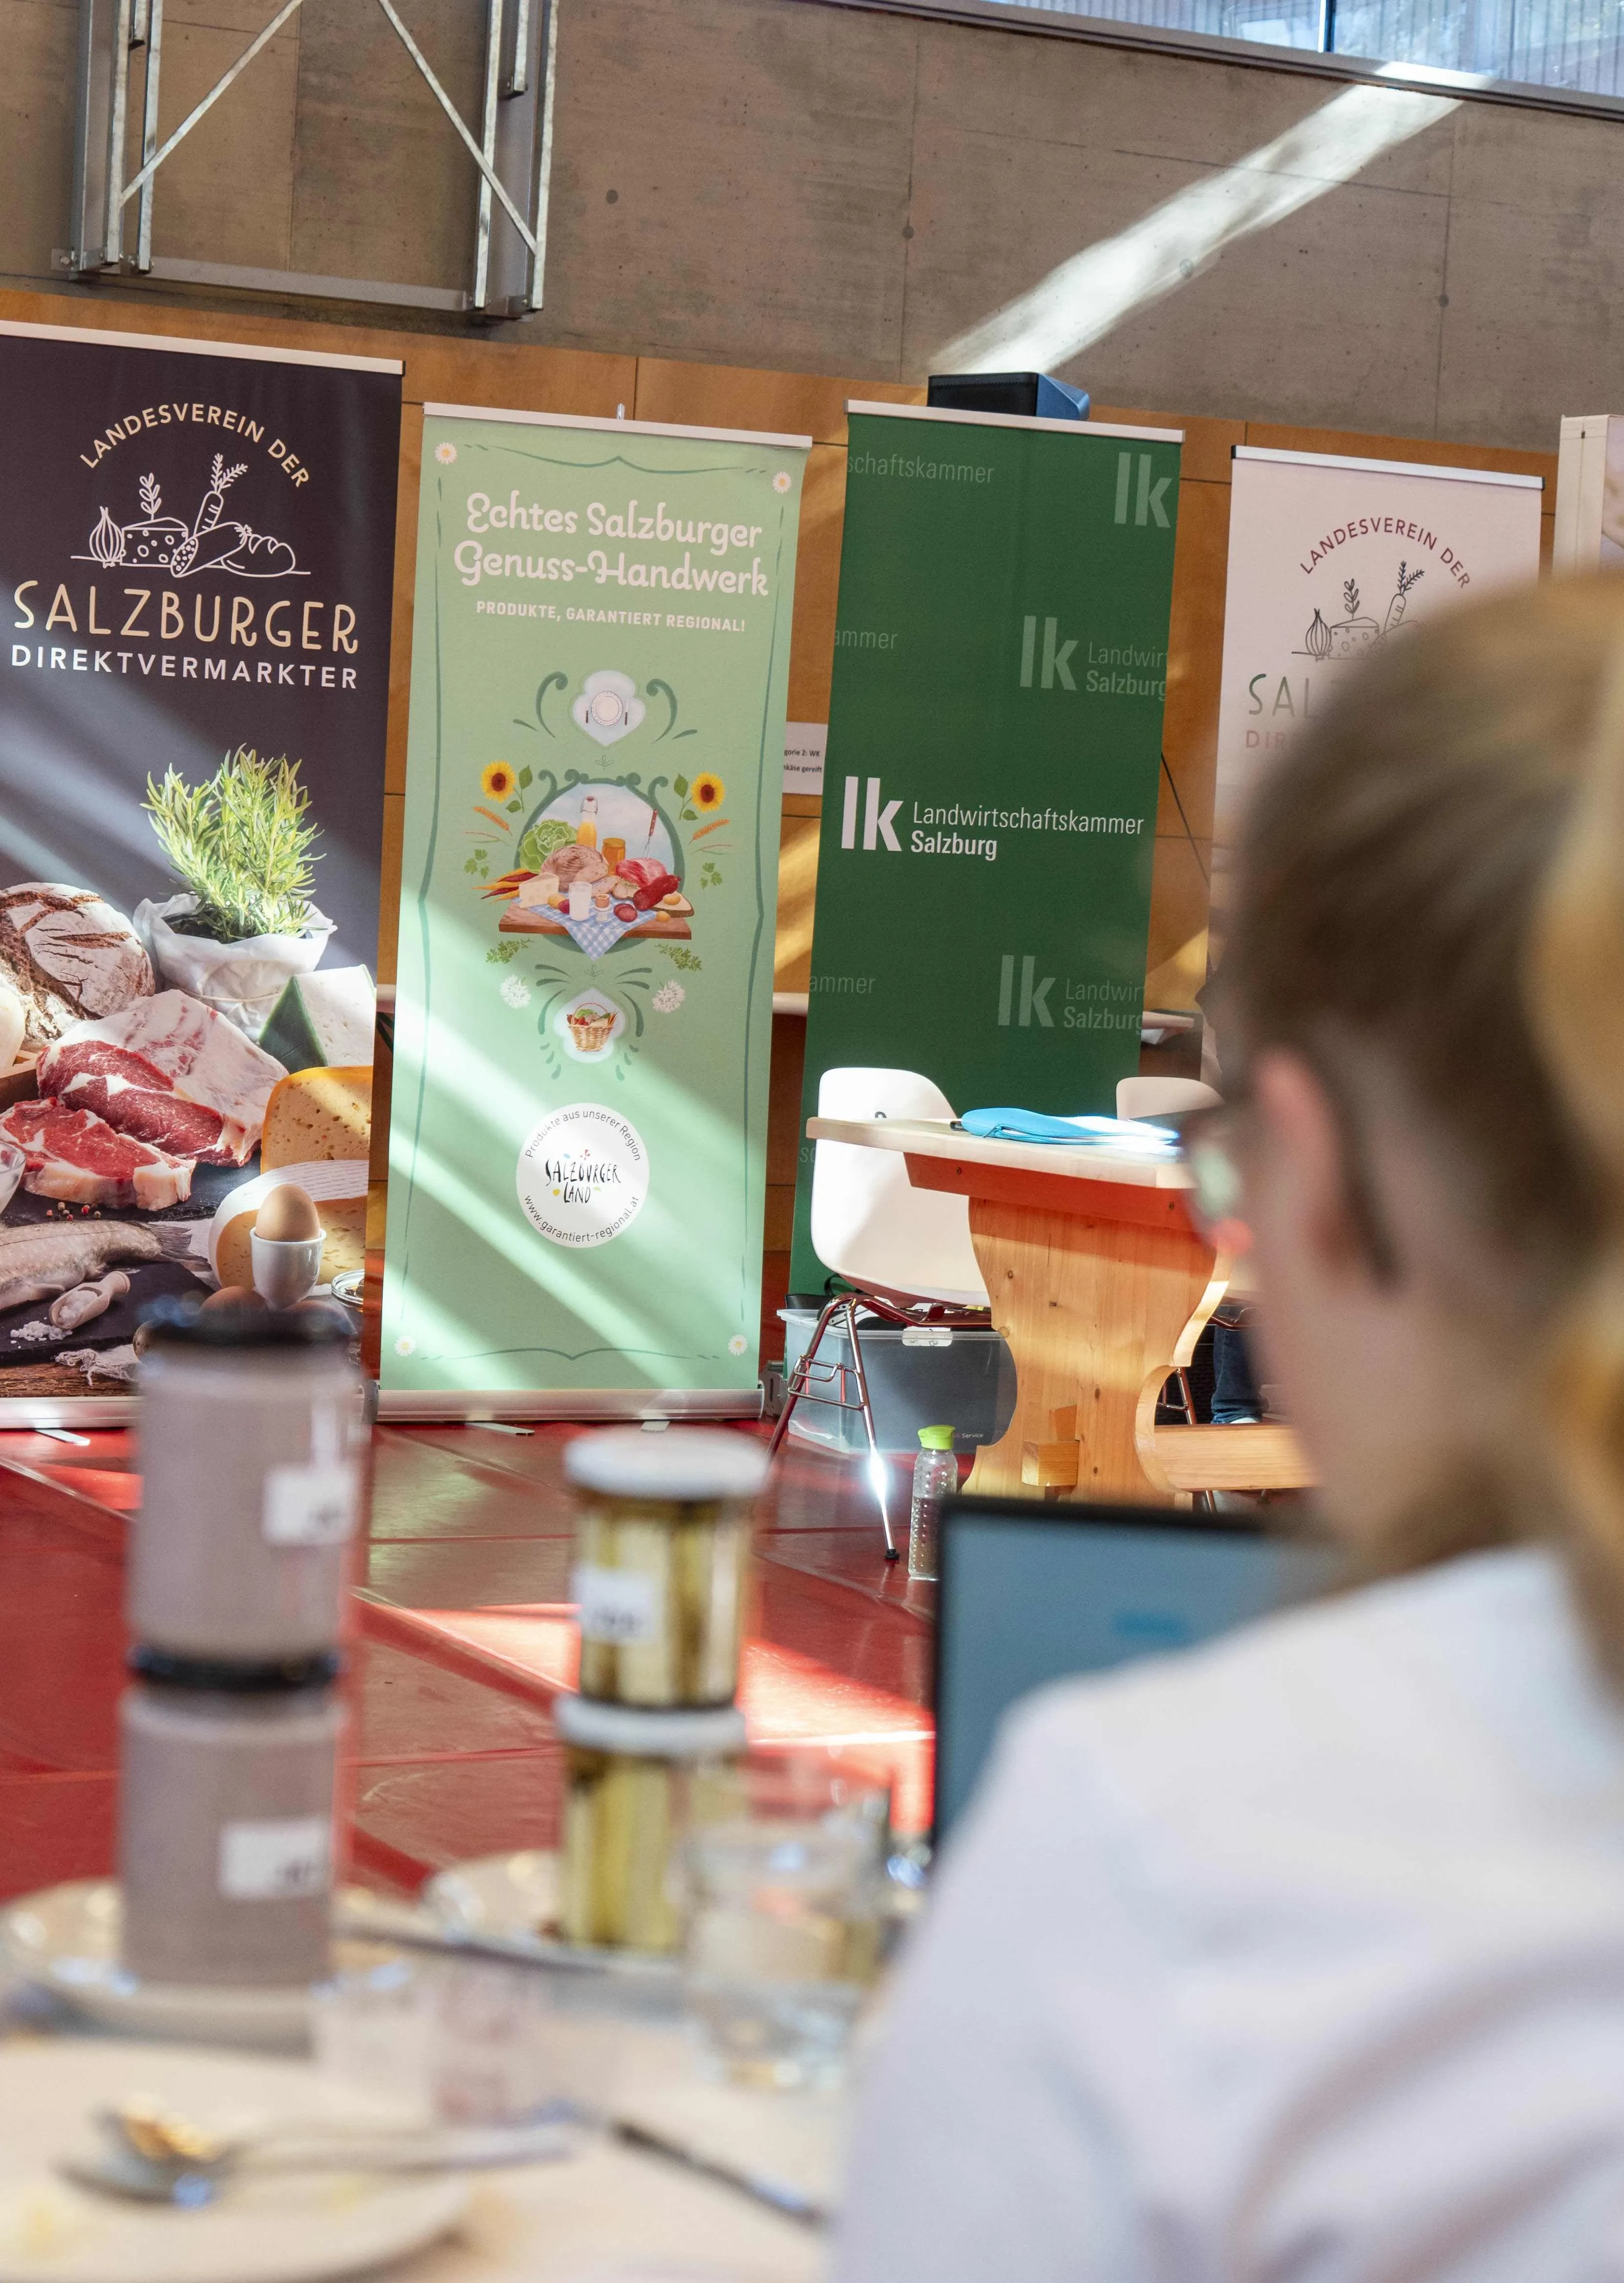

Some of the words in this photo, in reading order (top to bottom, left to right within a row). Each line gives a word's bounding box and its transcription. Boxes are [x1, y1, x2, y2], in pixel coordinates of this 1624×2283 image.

[81, 403, 264, 468] LANDESVEREIN
[268, 439, 309, 487] DER
[848, 451, 994, 483] schaftskammer
[467, 490, 577, 533] Echtes
[587, 500, 762, 556] Salzburger
[454, 540, 768, 596] Genuss-Handwerk
[1300, 517, 1437, 574] LANDESVEREIN
[1440, 548, 1470, 588] DER
[14, 581, 358, 654] SALZBURGER
[476, 601, 561, 622] PRODUKTE,
[566, 607, 662, 626] GARANTIERT
[666, 615, 745, 632] REGIONAL!
[12, 645, 357, 689] DIREKTVERMARKTER
[1086, 670, 1166, 701] Salzburg
[914, 802, 1144, 835] Landwirtschaftskammer
[911, 831, 997, 861] Salzburg
[1066, 978, 1142, 1001] Landwir
[525, 1118, 560, 1158] Produkte
[563, 1110, 580, 1121] aus
[583, 1111, 620, 1128] unserer
[620, 1125, 641, 1161] Region
[545, 1158, 621, 1186] SALZBURGER
[563, 1182, 591, 1204] LAND
[525, 1195, 639, 1242] www.garantiert-regional.at
